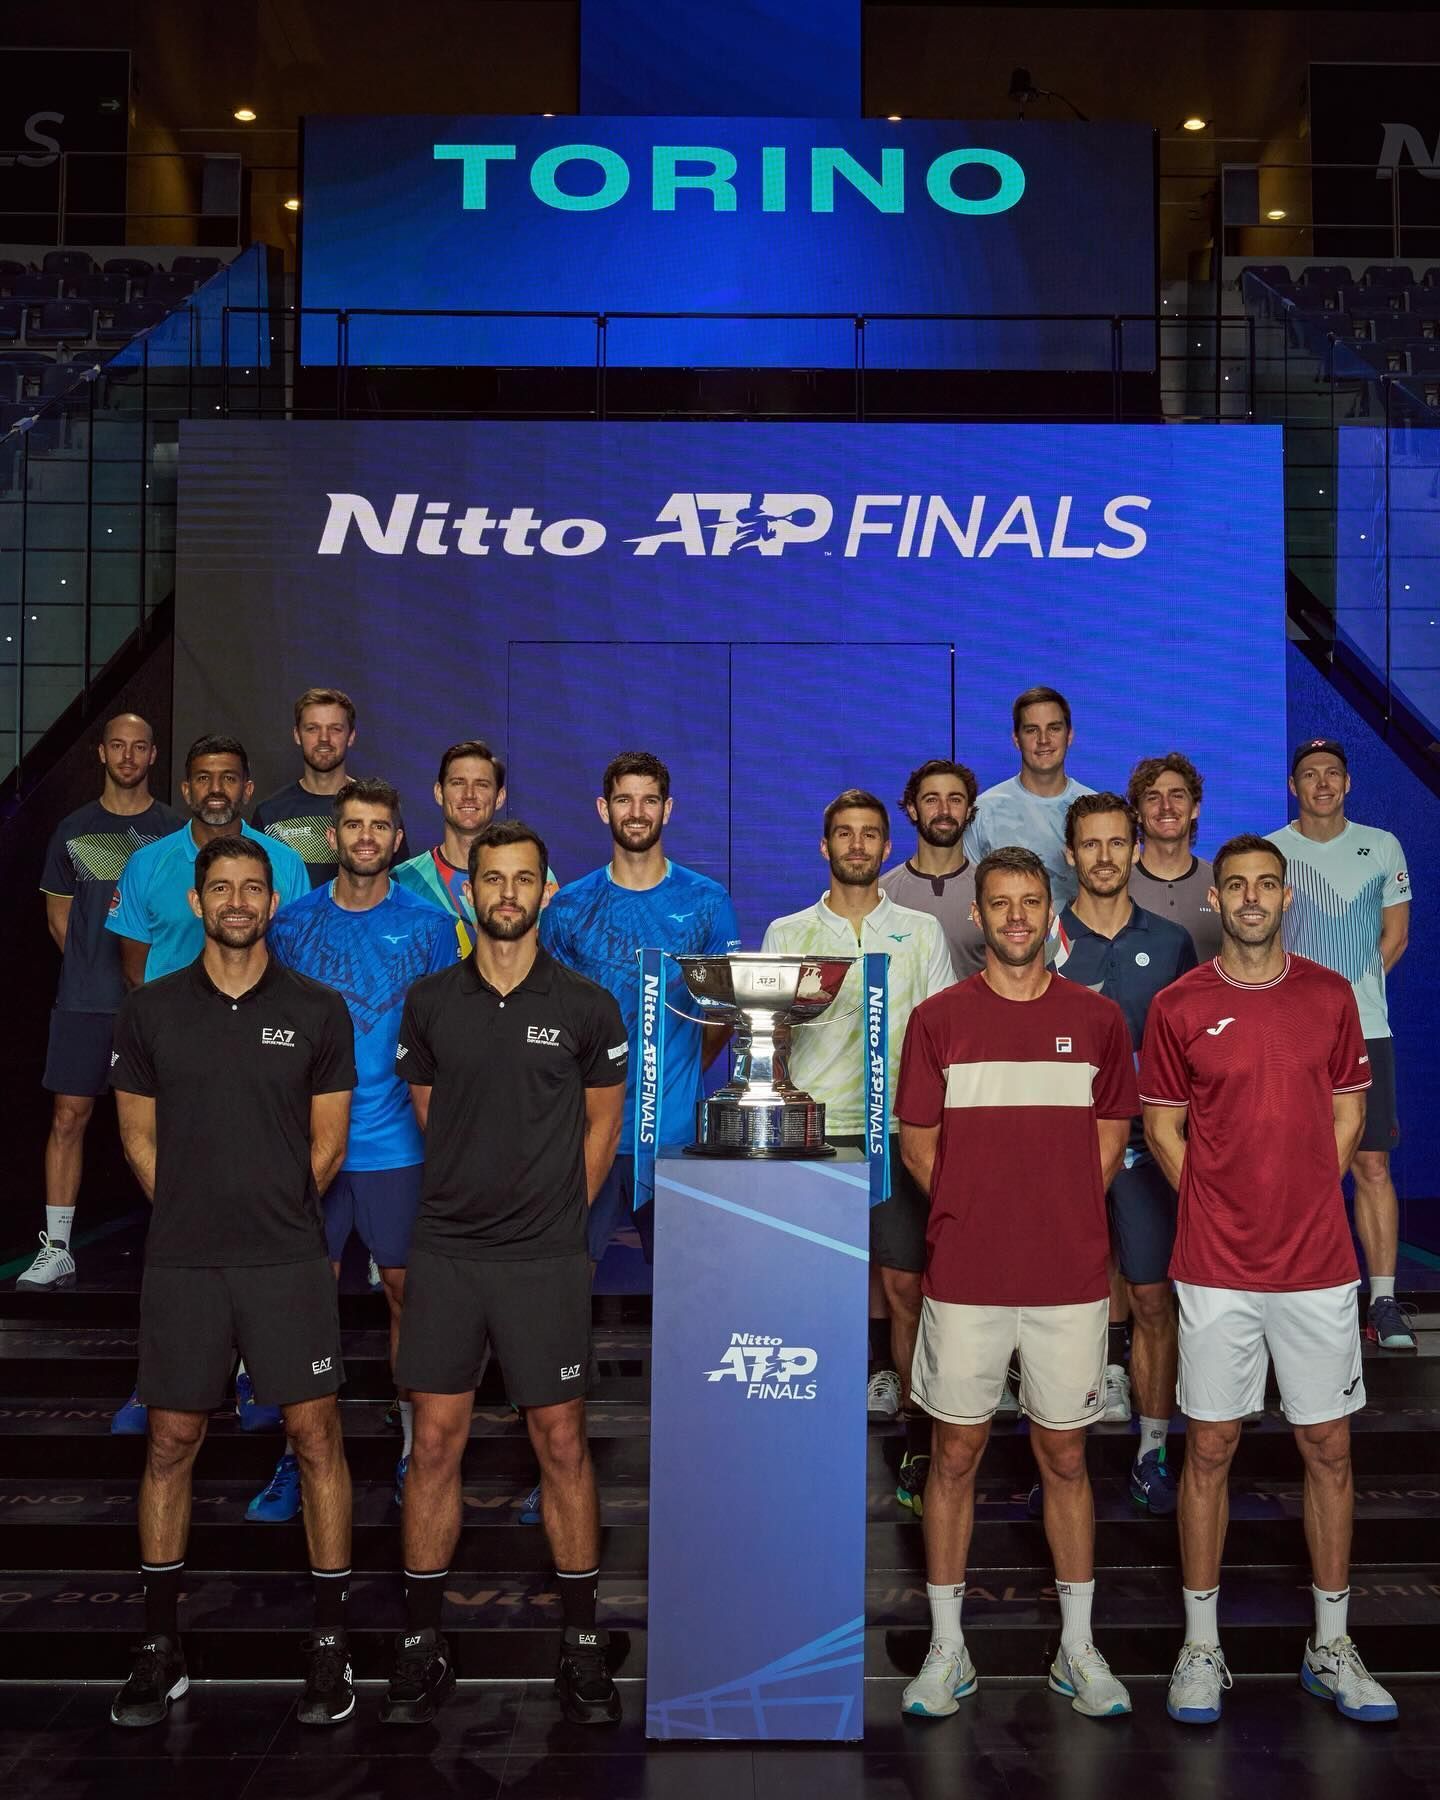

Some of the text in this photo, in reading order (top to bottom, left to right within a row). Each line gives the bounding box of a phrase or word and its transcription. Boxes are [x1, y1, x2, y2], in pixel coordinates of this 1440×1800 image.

[433, 144, 1026, 215] TORINO
[318, 493, 1150, 559] Nitto ATP FINALS
[262, 1028, 295, 1042] EA7
[527, 1026, 560, 1041] EA7
[640, 974, 659, 1144] Nitto ATP FINALS
[869, 986, 884, 1154] Nitto ATP FINALS
[730, 1333, 782, 1345] Nitto
[312, 1357, 331, 1372] EA7
[560, 1364, 580, 1378] EA7
[702, 1347, 817, 1382] ATP
[747, 1384, 817, 1400] FINALS
[405, 1636, 421, 1648] EA7
[579, 1635, 597, 1644] EA7
